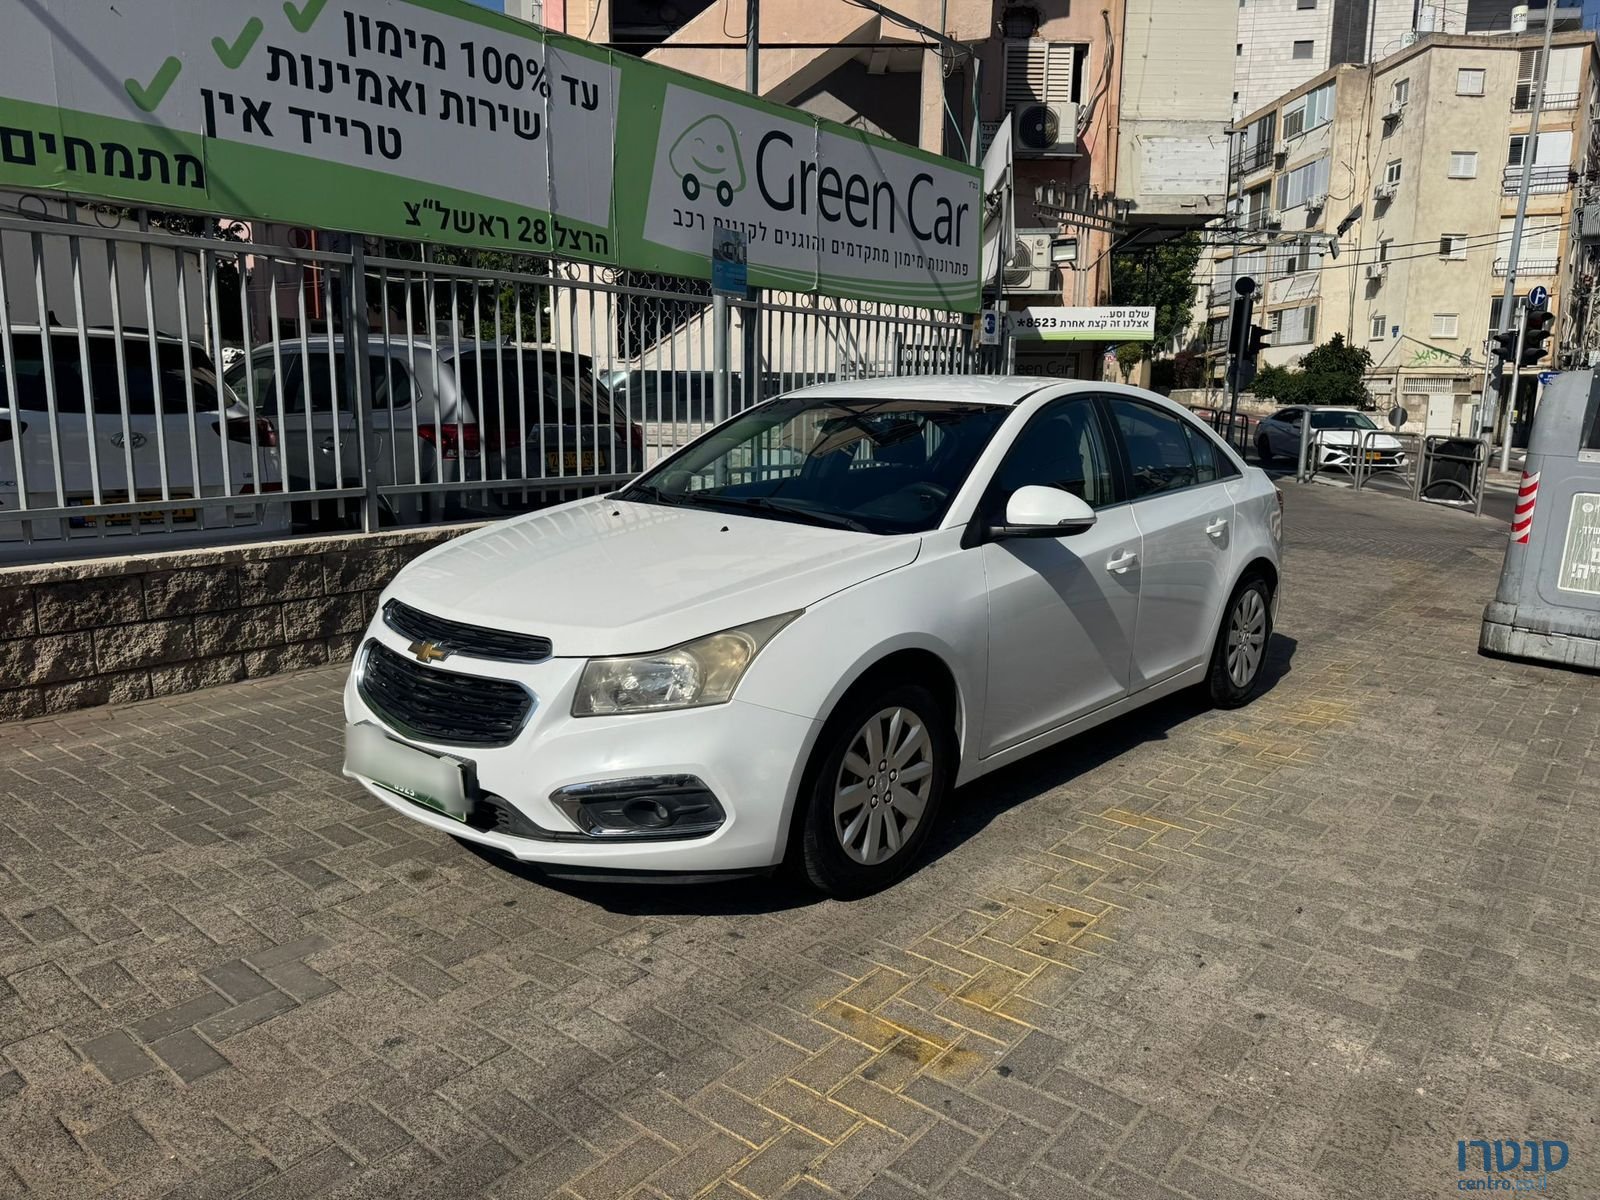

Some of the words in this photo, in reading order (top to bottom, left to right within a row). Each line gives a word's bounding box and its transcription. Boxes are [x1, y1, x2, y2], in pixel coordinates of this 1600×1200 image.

[343, 10, 446, 70] מימון
[266, 45, 426, 115] ואמינות
[460, 41, 551, 98] 100%
[561, 74, 599, 111] עד
[200, 88, 274, 139] אין
[439, 88, 541, 140] שירות
[288, 106, 402, 160] טרייד
[0, 126, 205, 189] מתמחים
[756, 130, 895, 233] Green
[907, 172, 969, 247] Car
[517, 215, 547, 245] 28
[673, 208, 705, 230] רכב
[554, 220, 609, 255] הרצל
[774, 229, 825, 252] והוגנים
[831, 239, 889, 263] מתקדמים
[894, 250, 924, 269] מימון
[927, 257, 969, 276] פתרונות
[984, 313, 996, 335] 3
[1060, 320, 1085, 328] אחרת
[1087, 320, 1107, 330] קצת
[1110, 320, 1121, 328] זה
[1123, 319, 1150, 328] אצלנו
[1129, 309, 1150, 318] שלם
[1047, 360, 1071, 375] Car
